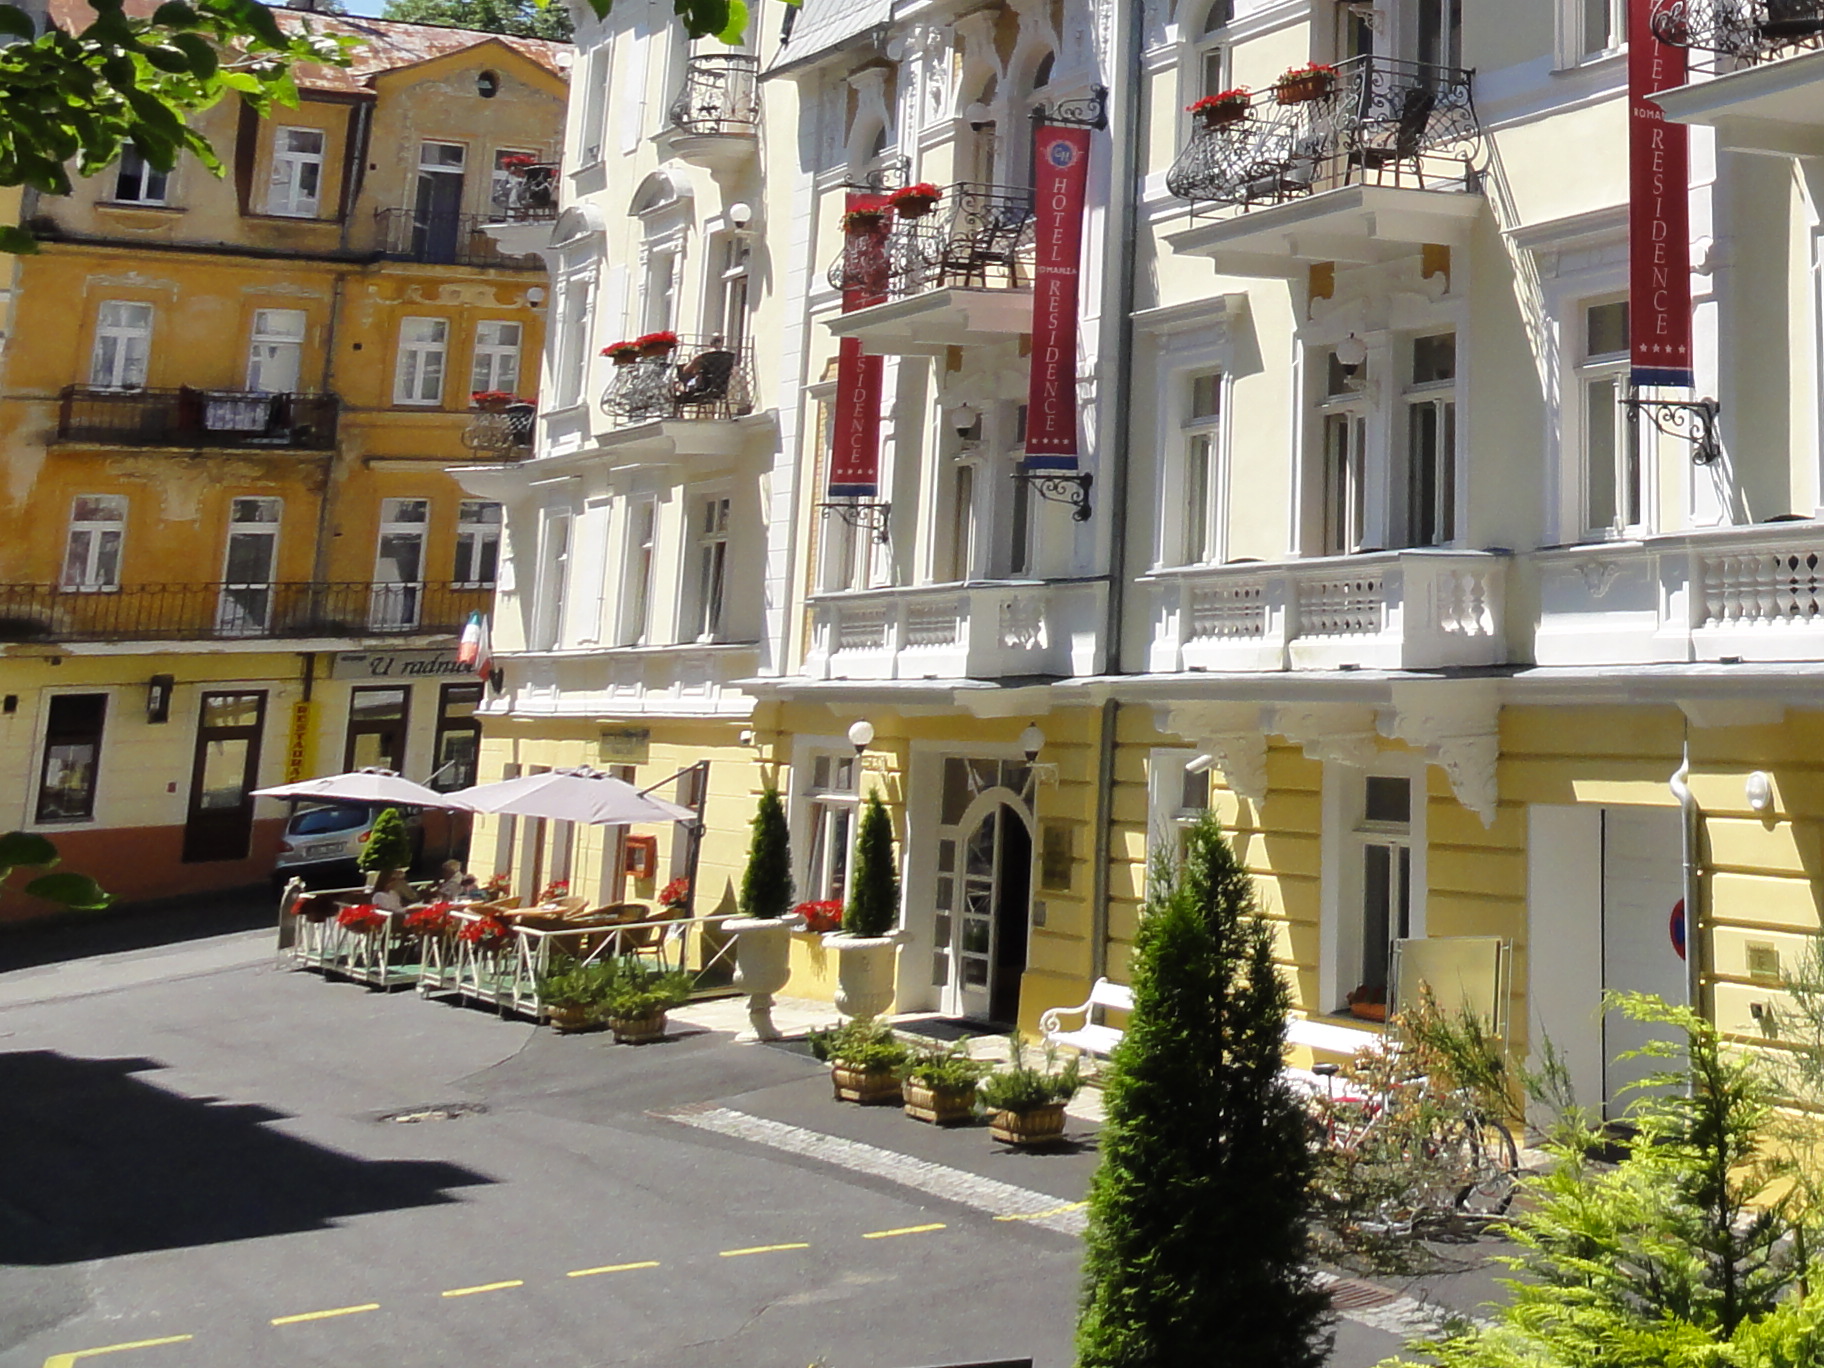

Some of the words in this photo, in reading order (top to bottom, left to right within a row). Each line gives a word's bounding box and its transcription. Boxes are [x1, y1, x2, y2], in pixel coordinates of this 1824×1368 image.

[1633, 107, 1665, 121] ROMA
[1052, 178, 1067, 261] HOTEL
[1651, 128, 1668, 335] RESIDENCE
[851, 340, 866, 463] ESIDENCE
[1044, 279, 1061, 431] RESIDENCE
[369, 656, 395, 676] U
